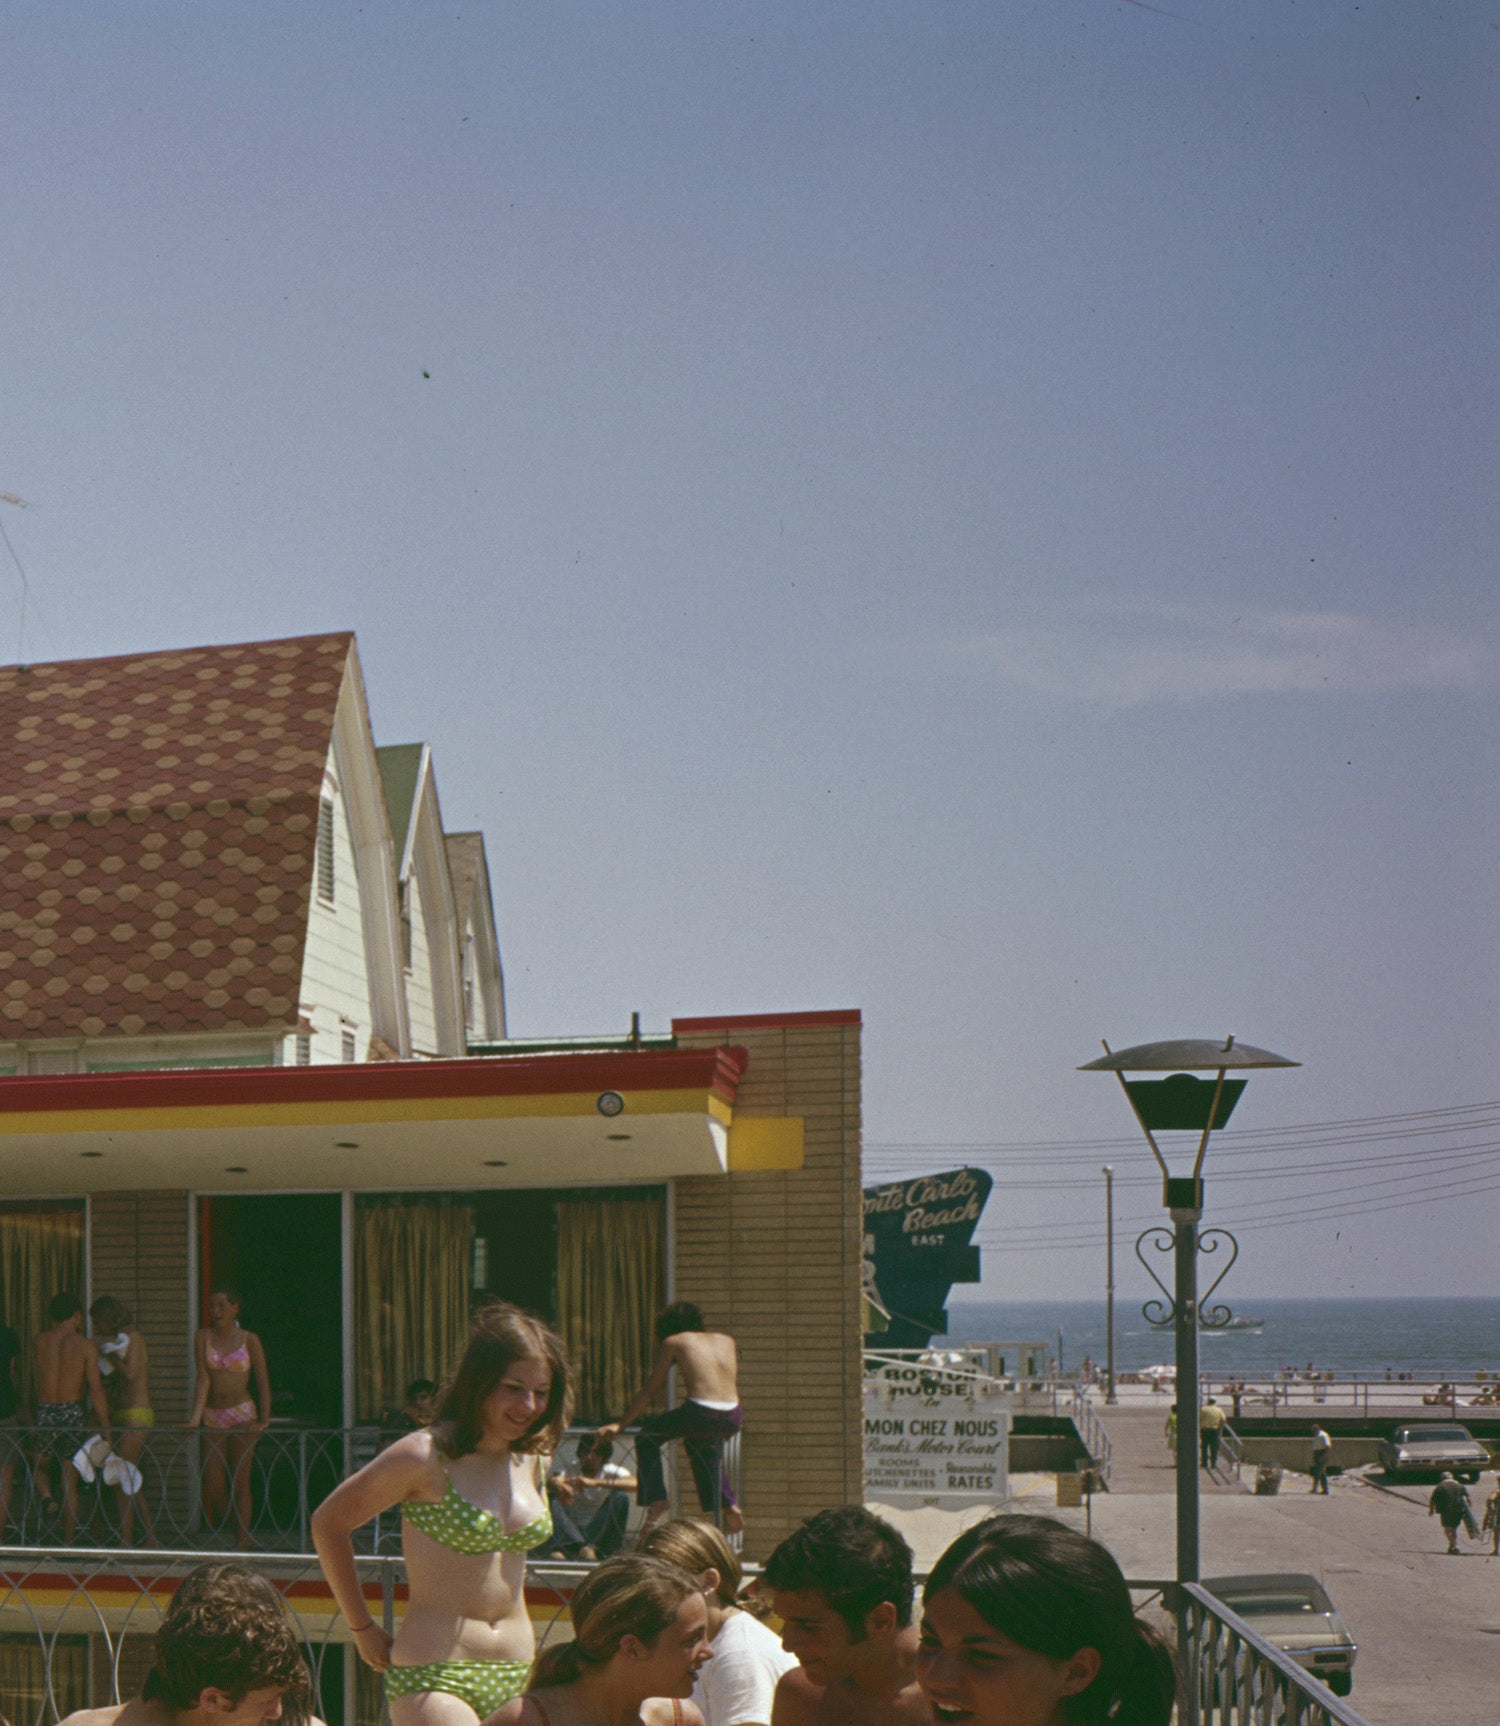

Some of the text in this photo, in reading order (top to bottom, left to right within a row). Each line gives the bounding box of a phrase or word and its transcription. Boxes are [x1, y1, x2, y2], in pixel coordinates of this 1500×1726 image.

[905, 1170, 978, 1206] Carlo
[903, 1192, 979, 1233] Beach
[911, 1234, 945, 1246] EAST
[865, 1419, 998, 1436] MON CHEZ NOUS
[956, 1439, 1001, 1455] Court
[879, 1458, 920, 1466] ROOMS
[903, 1479, 936, 1488] UNITS
[947, 1475, 993, 1489] RATES
